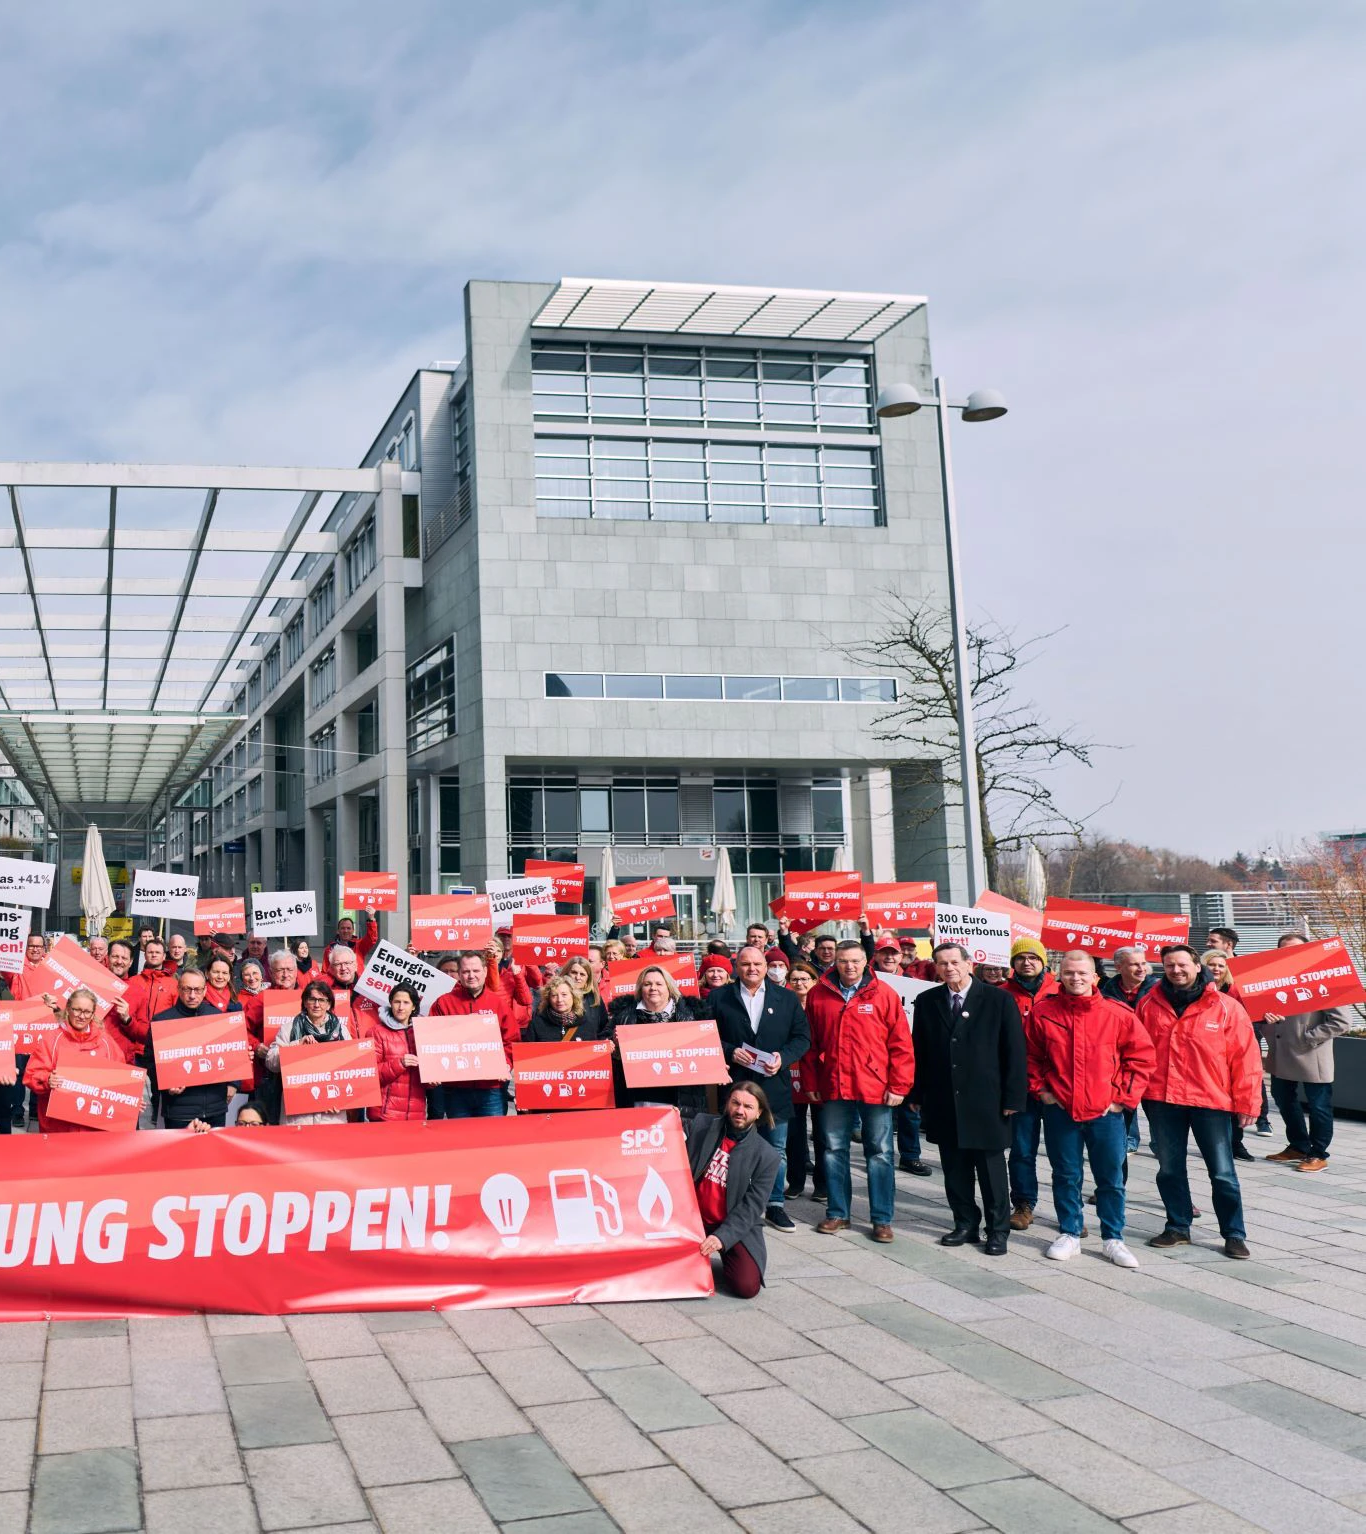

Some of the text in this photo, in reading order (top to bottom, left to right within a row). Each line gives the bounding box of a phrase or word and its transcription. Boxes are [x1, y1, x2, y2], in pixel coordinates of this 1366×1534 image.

[617, 852, 660, 866] Stüberl
[18, 874, 50, 884] +41%
[556, 878, 582, 887] STOPPEN!
[135, 888, 196, 897] Strom +12%
[490, 884, 546, 902] Teuerungs-
[826, 892, 860, 900] STOPPEN!
[492, 900, 524, 913] 100er
[614, 893, 670, 909] TEUERUNG STOPPEN!
[255, 902, 312, 920] Brot +6%
[414, 918, 490, 926] TEUERUNG STOPPEN!
[938, 914, 987, 924] 300 Euro
[938, 925, 1010, 937] Winterbonus
[1047, 919, 1090, 932] TEUERUNG
[1092, 926, 1133, 940] STOPPEN!
[516, 936, 586, 946] TEUERUNG STOPPEN!
[1145, 933, 1186, 944] STOPPEN!
[1322, 940, 1340, 950] SPÖ
[377, 948, 434, 978] Energie-
[372, 963, 426, 992] steuern
[1242, 966, 1352, 994] TEUERUNG STOPPEN!
[29, 1023, 60, 1031] STOPPEN
[158, 1041, 246, 1060] TEUERUNG STOPPEN!
[358, 1040, 372, 1049] SPÖ
[421, 1042, 501, 1054] TEUERUNG STOPPEN!
[593, 1044, 607, 1052] SPÖ
[626, 1047, 720, 1060] TEUERUNG STOPPEN!
[286, 1067, 376, 1085] TEUERUNG STOPPEN!
[518, 1070, 610, 1080] TEUERUNG STOPPEN!
[60, 1079, 139, 1108] EUERUNG STOPPEN!
[620, 1124, 665, 1148] SPÖ
[148, 1185, 452, 1260] STOPPEN!
